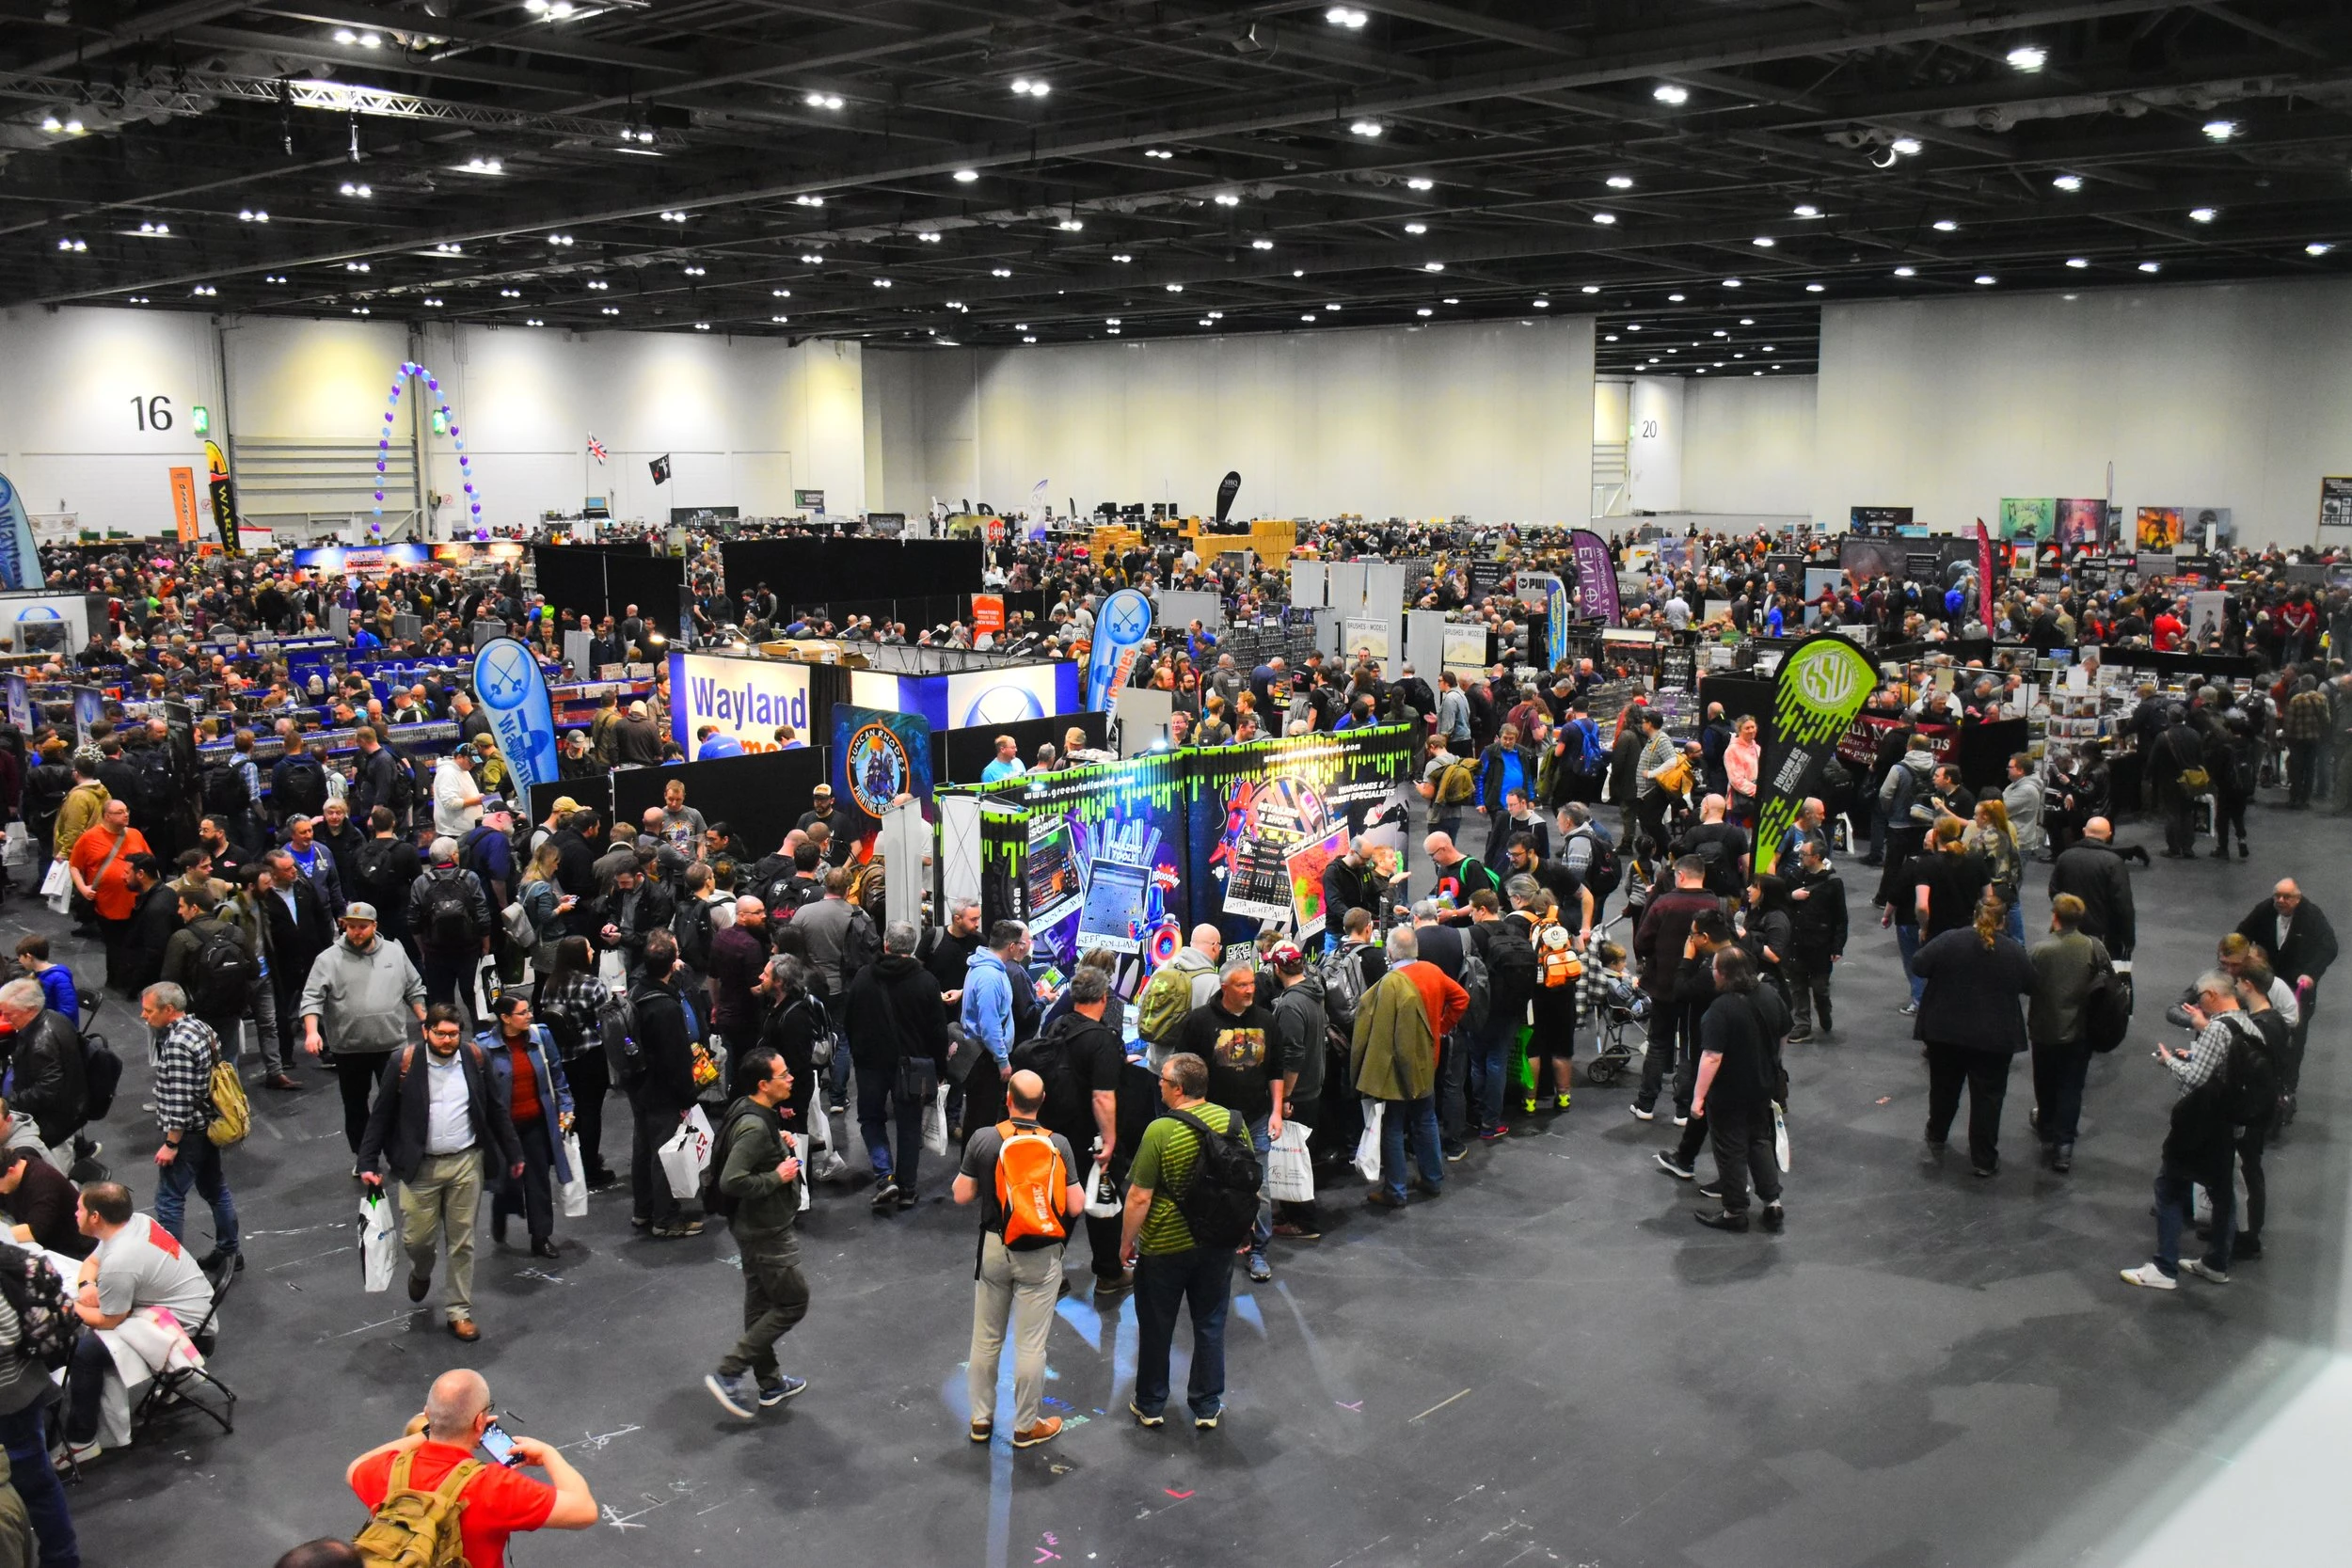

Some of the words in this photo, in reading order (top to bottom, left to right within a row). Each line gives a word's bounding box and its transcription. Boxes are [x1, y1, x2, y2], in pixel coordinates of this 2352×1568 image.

[130, 395, 173, 431] 16
[1643, 420, 1657, 438] 20
[1529, 578, 1547, 589] PUL
[1347, 622, 1366, 630] BRUSHES
[1370, 624, 1387, 632] MODELS
[1802, 653, 1853, 704] GSW
[691, 676, 807, 731] Wayland
[850, 728, 876, 765] DUNCAN
[877, 730, 906, 772] RHODES
[1773, 757, 1796, 788] FOLLOW
[1789, 747, 1802, 760] US
[1338, 782, 1377, 795] WARGAMES
[1378, 781, 1385, 789] &
[1350, 788, 1395, 800] SPECIALISTS
[853, 784, 878, 814] PAINTING
[1265, 813, 1295, 826] SHOPS
[1112, 849, 1136, 863] TOOLS
[1078, 934, 1101, 945] KEEP
[1100, 940, 1138, 950] ROLLING
